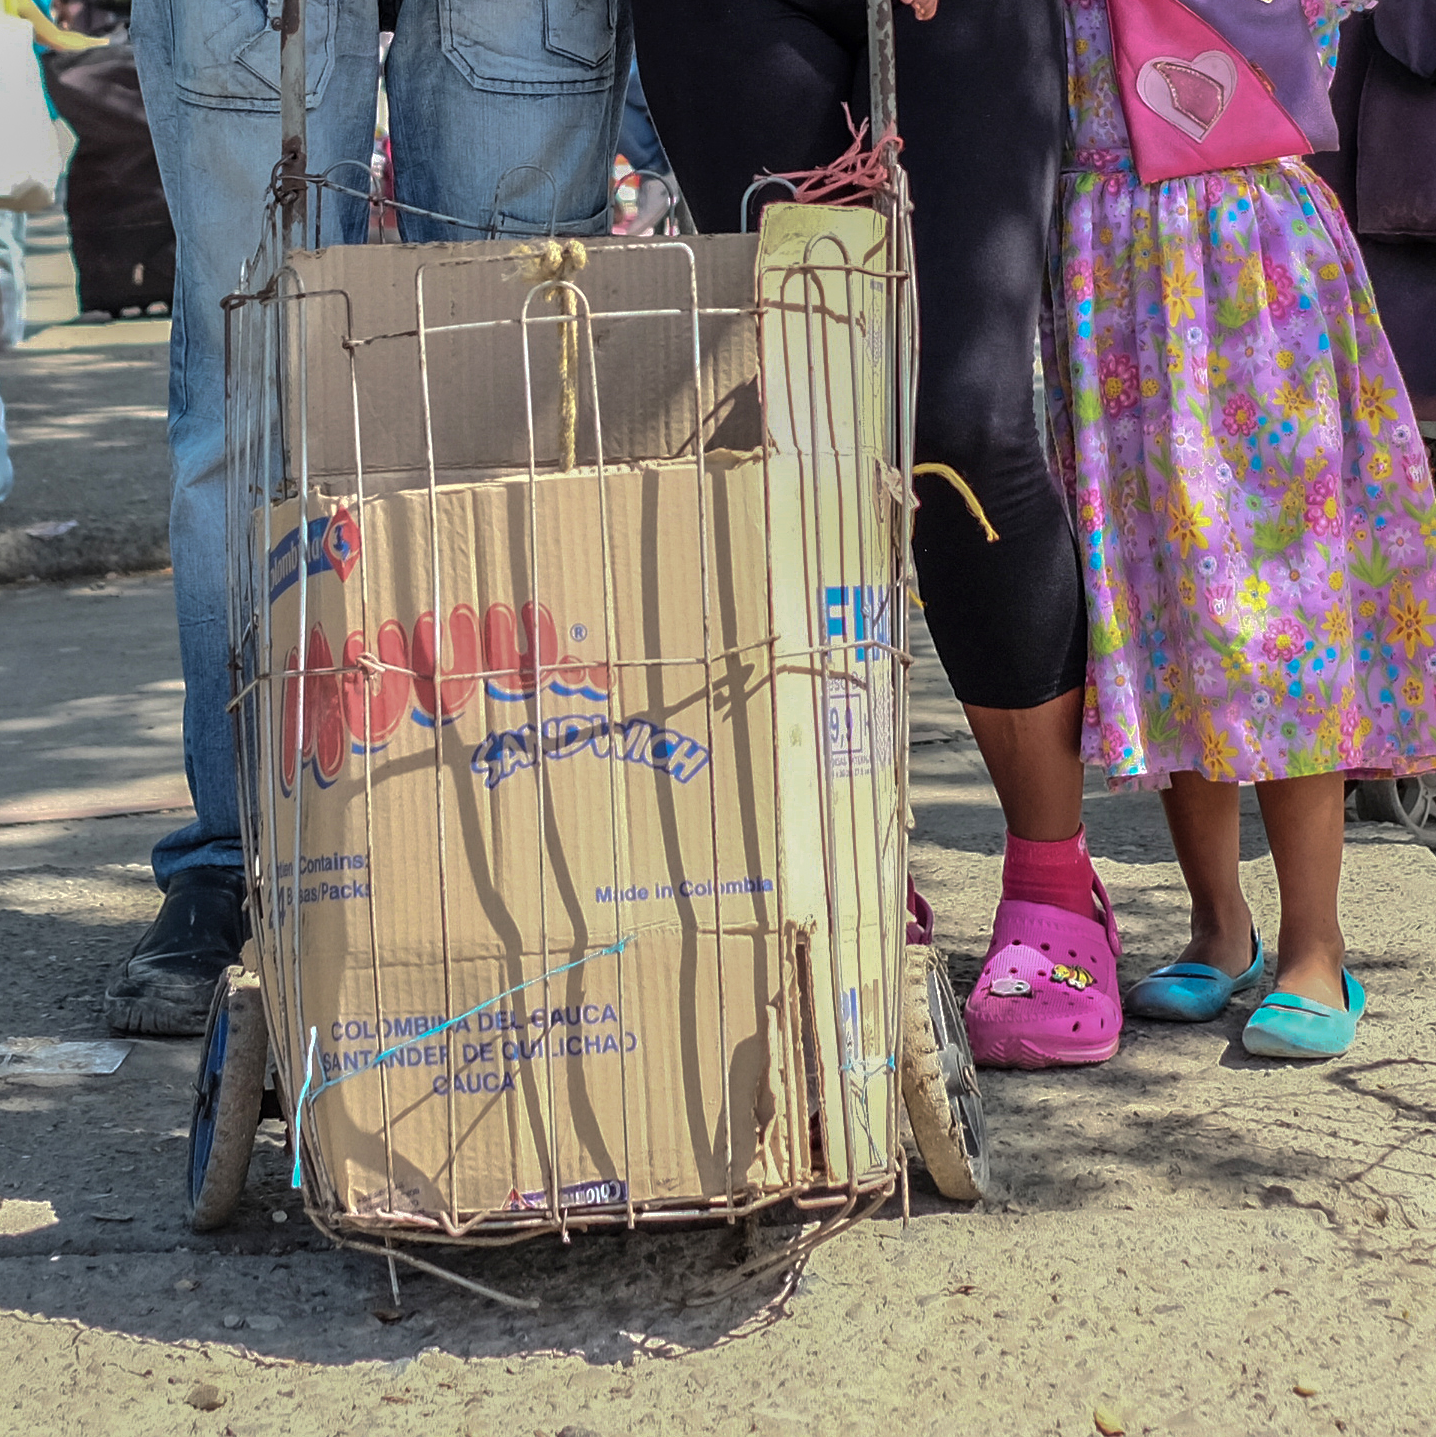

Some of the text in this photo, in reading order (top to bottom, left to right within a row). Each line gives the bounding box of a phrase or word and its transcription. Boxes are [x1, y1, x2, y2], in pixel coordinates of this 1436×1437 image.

[470, 713, 710, 790] SANDWICH
[287, 880, 371, 906] Bsas/Packs
[595, 884, 649, 903] Made
[477, 1010, 523, 1032] DEL
[530, 1003, 618, 1028] CAUCA
[463, 1040, 495, 1063] DE
[432, 1072, 515, 1096] CAUCA
